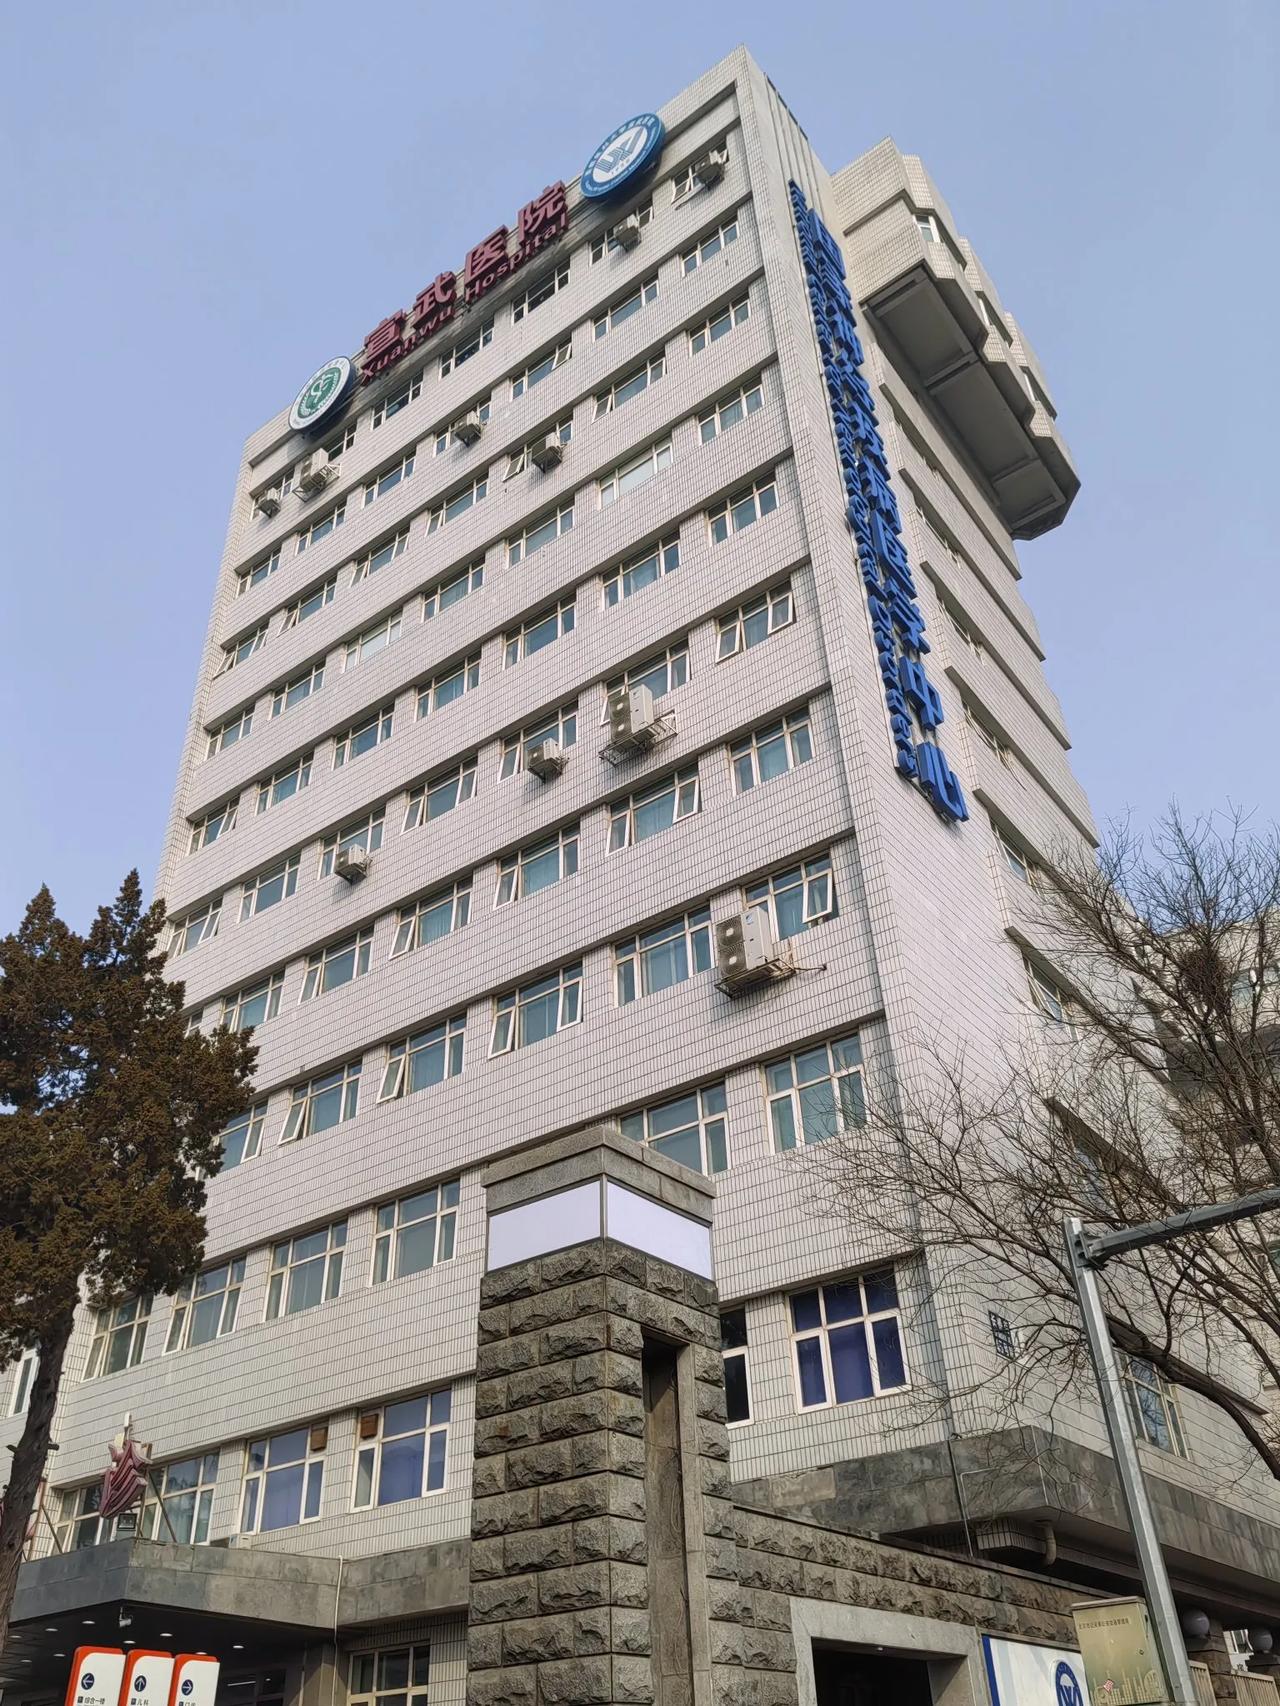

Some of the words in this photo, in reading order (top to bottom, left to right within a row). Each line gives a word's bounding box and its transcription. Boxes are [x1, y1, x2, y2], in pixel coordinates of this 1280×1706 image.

[361, 181, 569, 369] 宣武医院
[361, 306, 456, 386] Xuanwu
[464, 212, 570, 304] Hospital
[830, 397, 888, 600] Neurological
[868, 594, 918, 778] Disorders
